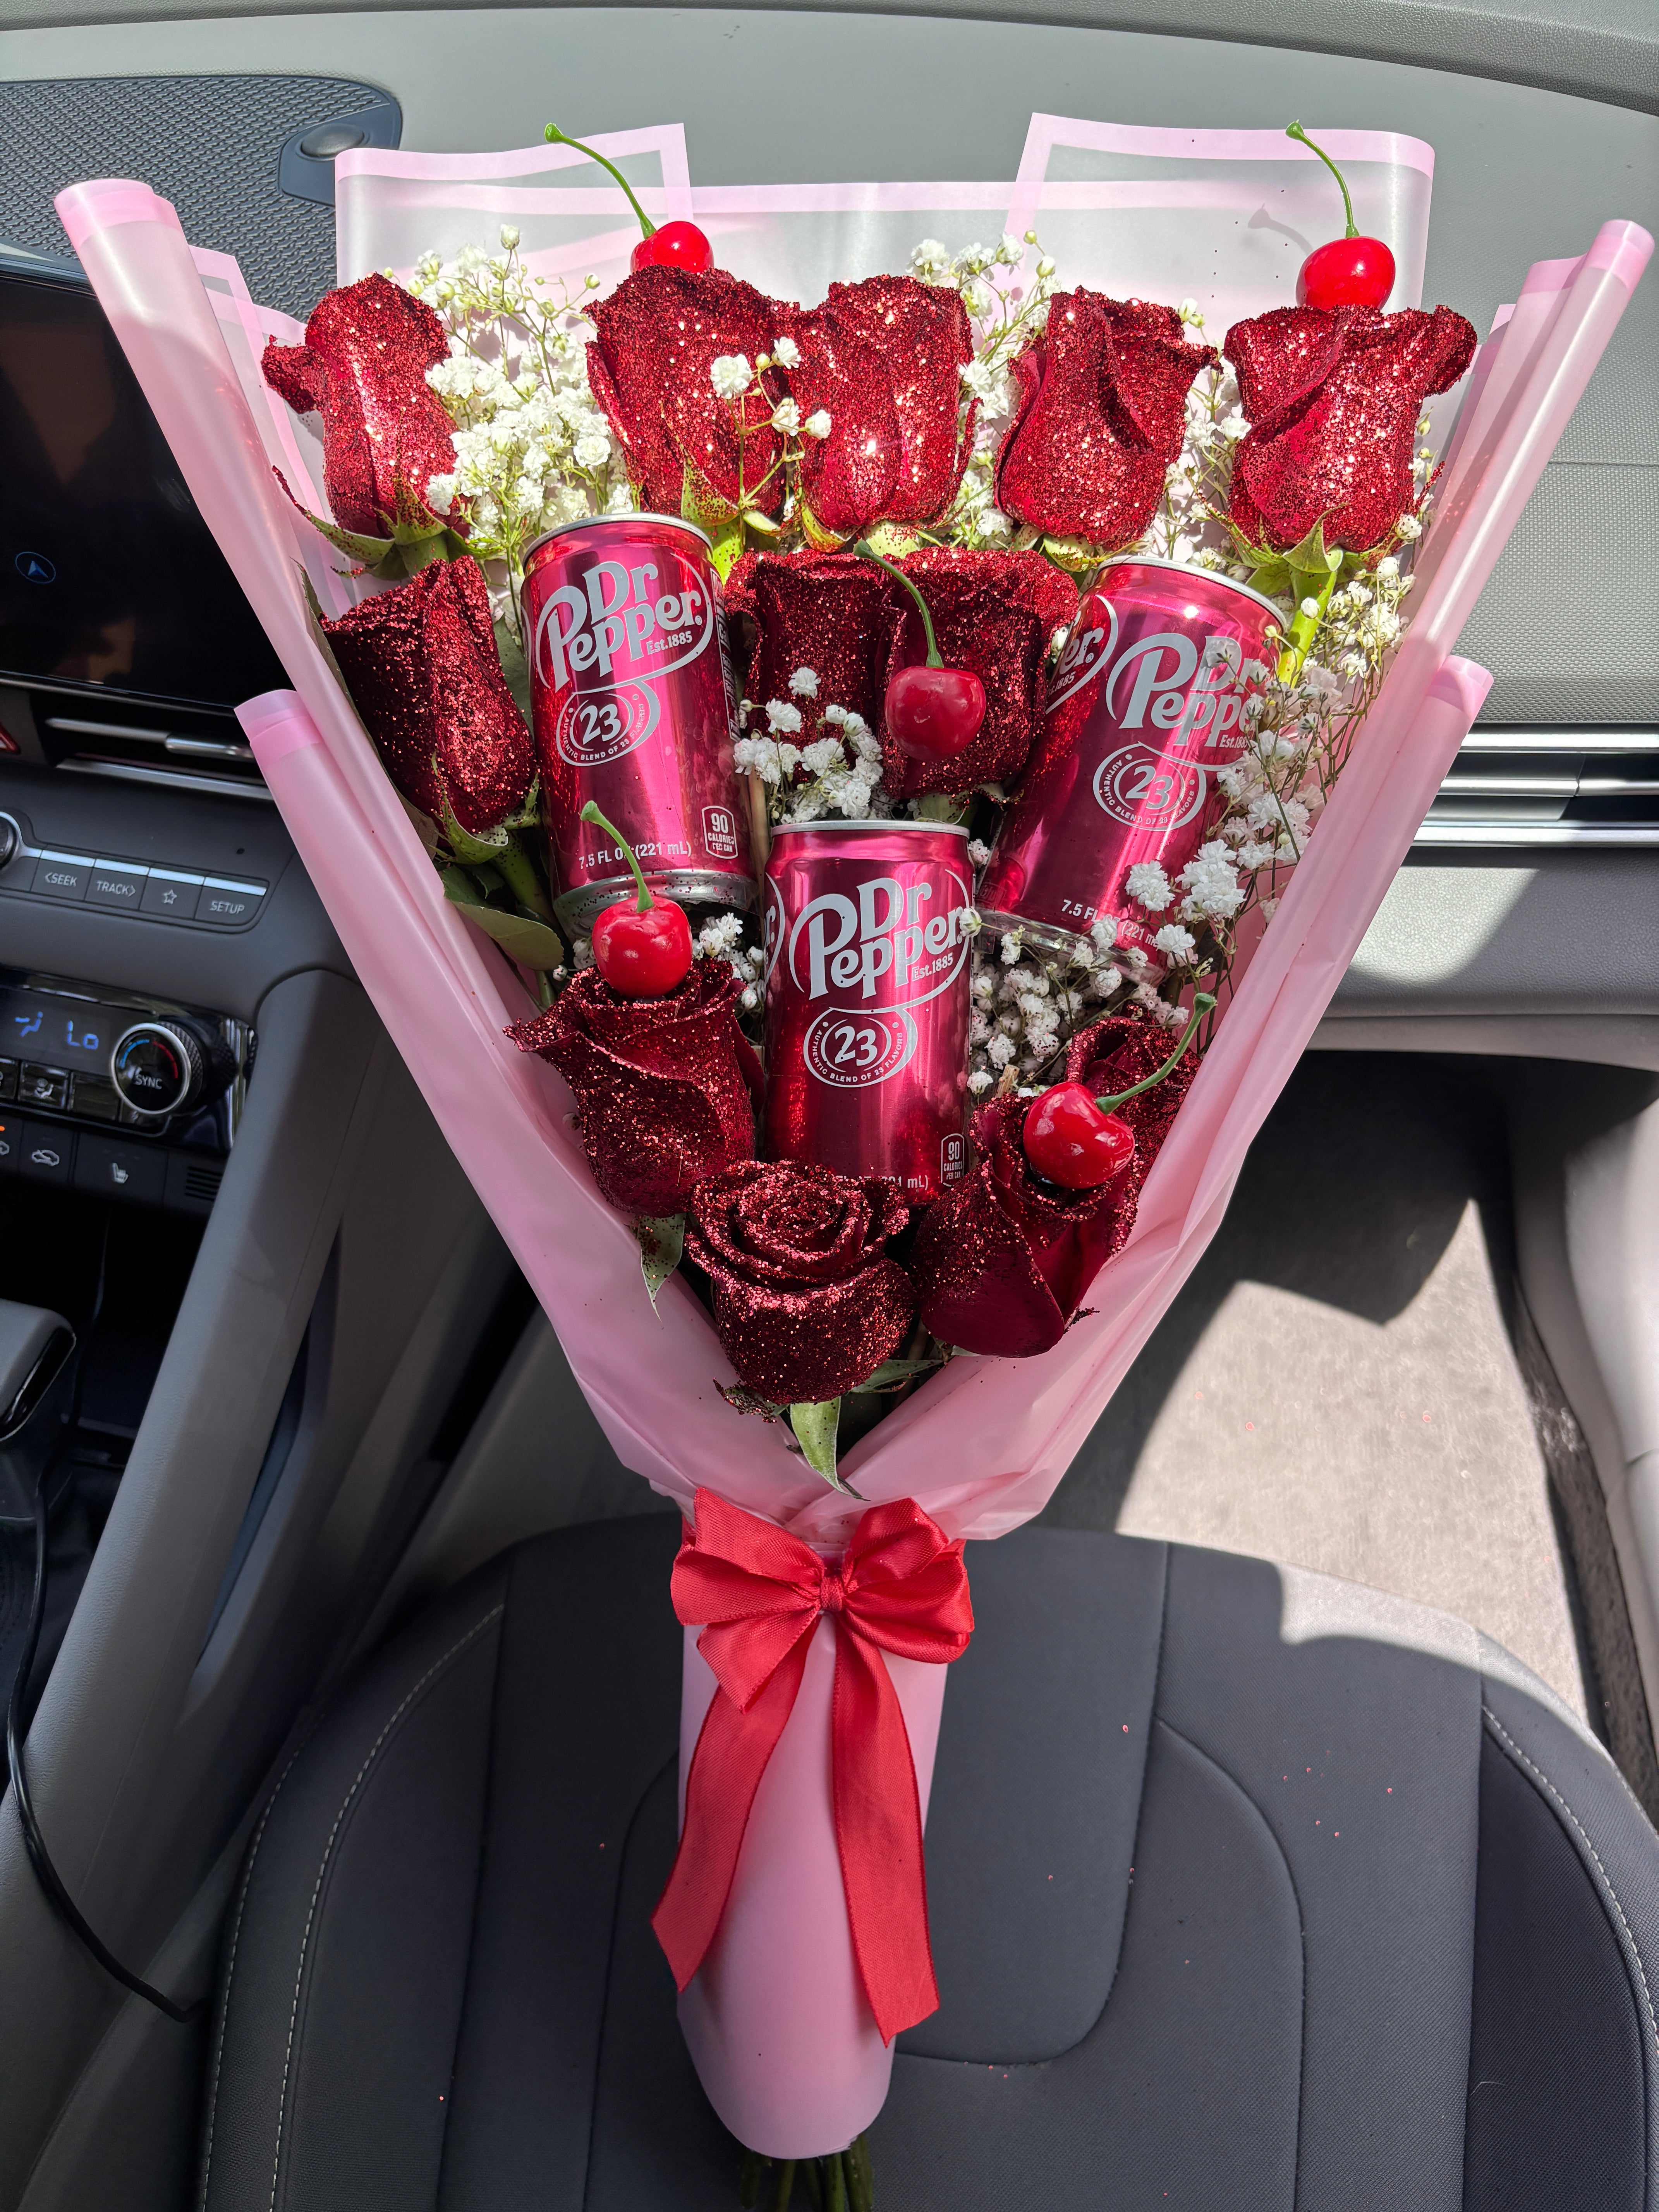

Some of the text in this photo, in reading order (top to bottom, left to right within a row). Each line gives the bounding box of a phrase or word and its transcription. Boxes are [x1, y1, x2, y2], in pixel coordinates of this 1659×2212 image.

[582, 561, 658, 625] Dr
[1189, 635, 1261, 693] Dr
[562, 715, 579, 759] AUTHENTIC
[580, 751, 606, 761] BLEND
[608, 745, 619, 754] OF
[620, 738, 630, 748] 23
[579, 703, 621, 745] 23
[1103, 759, 1123, 806] AUTHENTIC
[1115, 805, 1142, 823] BLEND
[1125, 765, 1174, 810] 23
[707, 832, 735, 846] CALORIES
[711, 812, 729, 834] 90
[578, 853, 595, 870] 7.5
[598, 849, 612, 865] FL
[635, 842, 663, 860] (221
[668, 840, 692, 857] mL)
[209, 900, 245, 915] SETUP
[856, 877, 932, 943] Dr
[1061, 899, 1083, 917] 7.5
[1121, 920, 1145, 941] (221
[812, 1029, 903, 1082] AUTHENTIC BLEND OF 23 FLAVORS
[835, 1025, 878, 1066] 23
[134, 1074, 163, 1090] SYNC
[948, 1141, 960, 1161] 90
[907, 1175, 929, 1191] mL)
